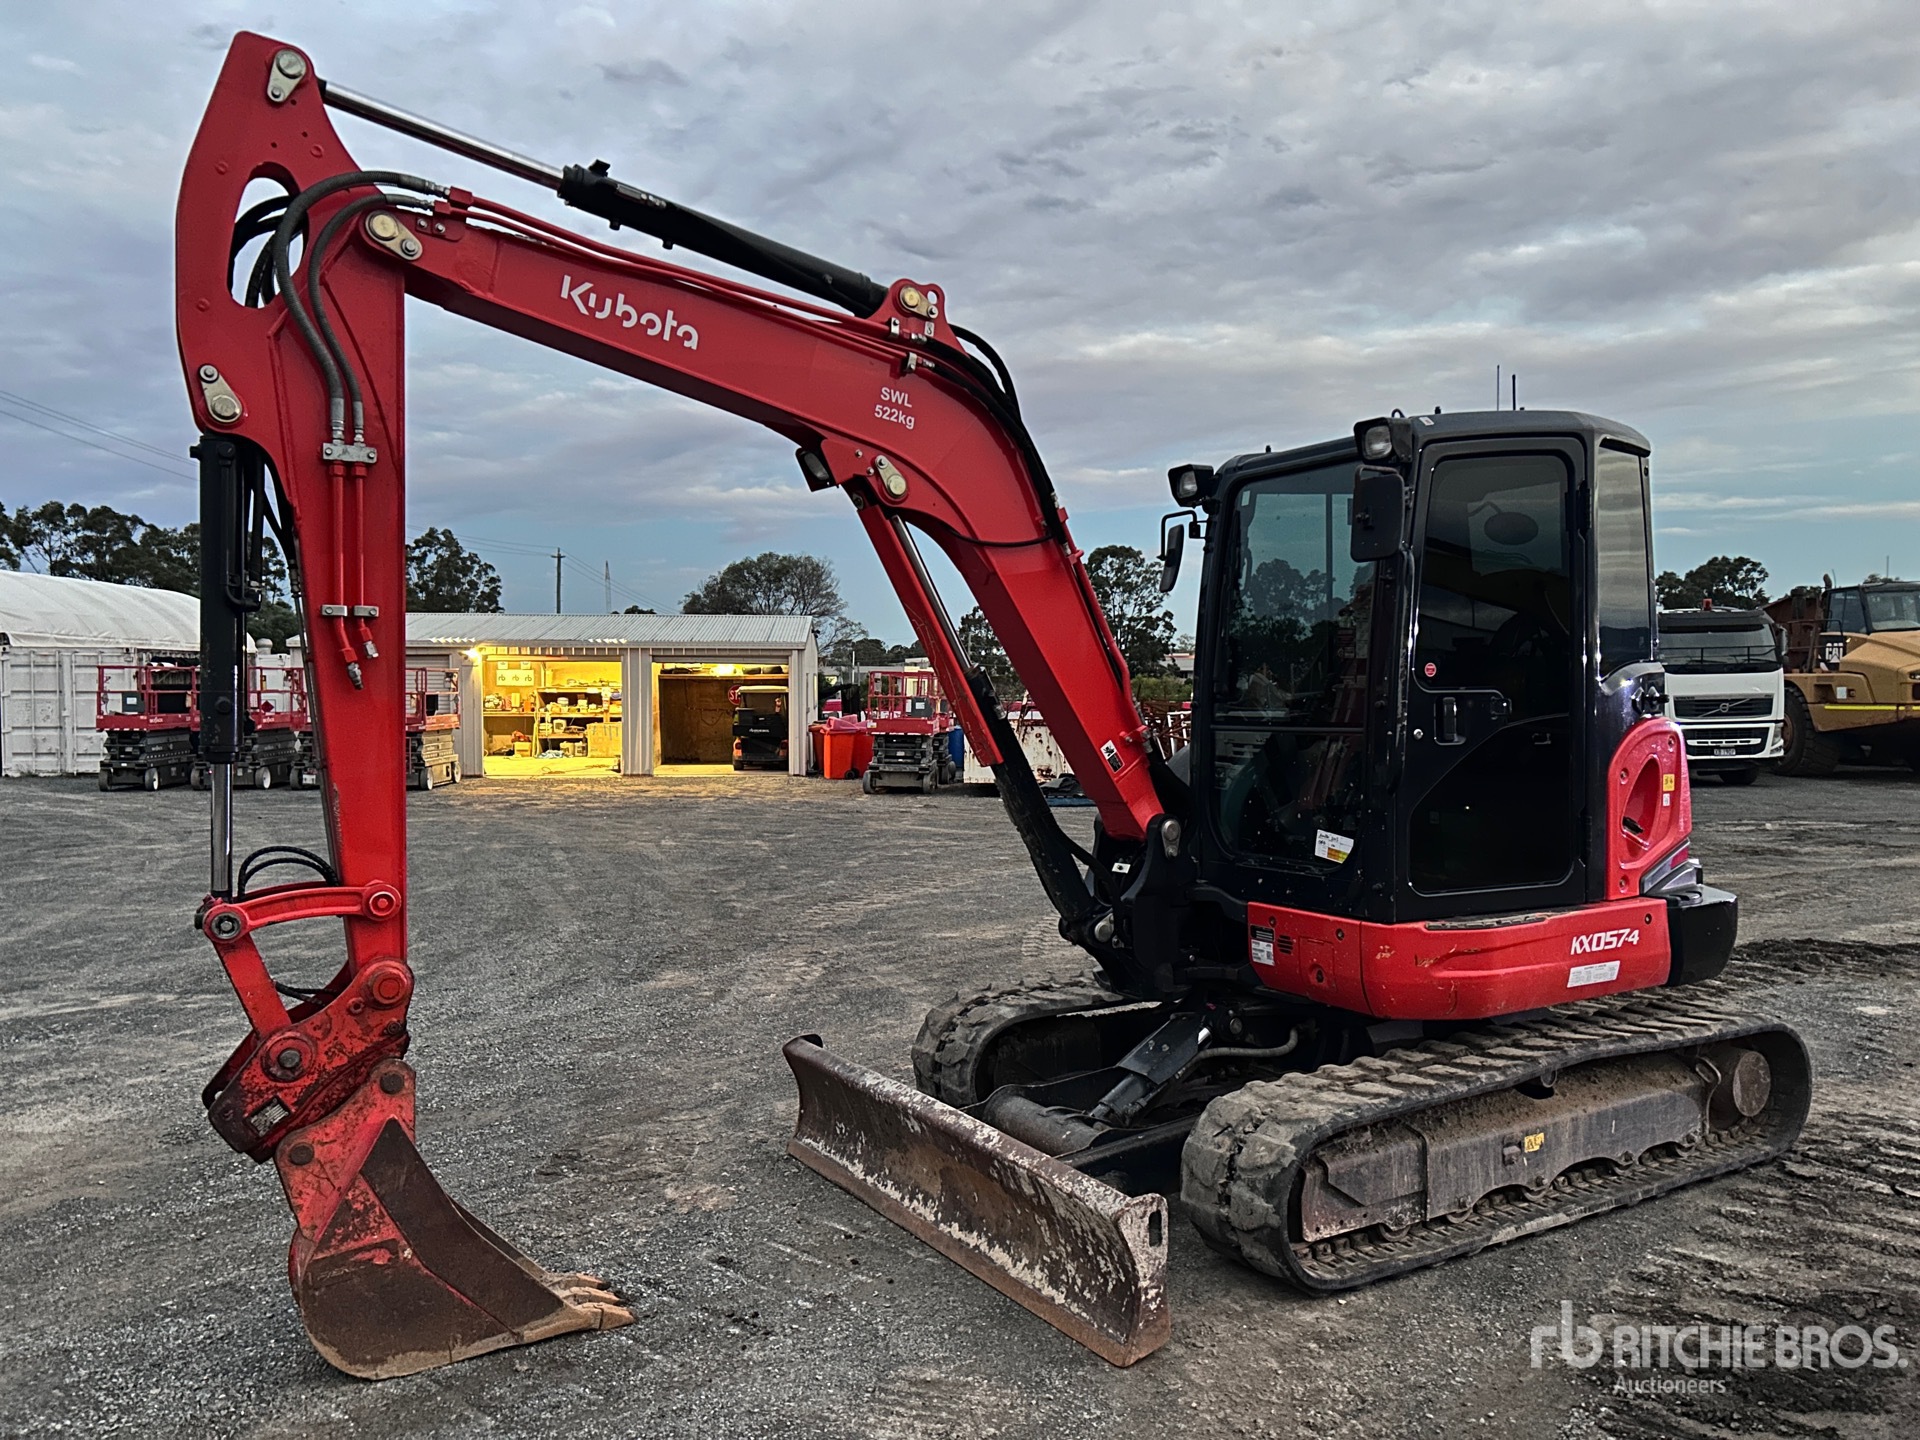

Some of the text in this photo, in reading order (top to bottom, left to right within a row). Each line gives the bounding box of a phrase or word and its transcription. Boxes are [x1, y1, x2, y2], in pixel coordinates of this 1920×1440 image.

[560, 274, 699, 351] Kubota
[880, 386, 913, 408] SWL
[874, 404, 915, 430] 522kg
[1825, 642, 1844, 663] CAT
